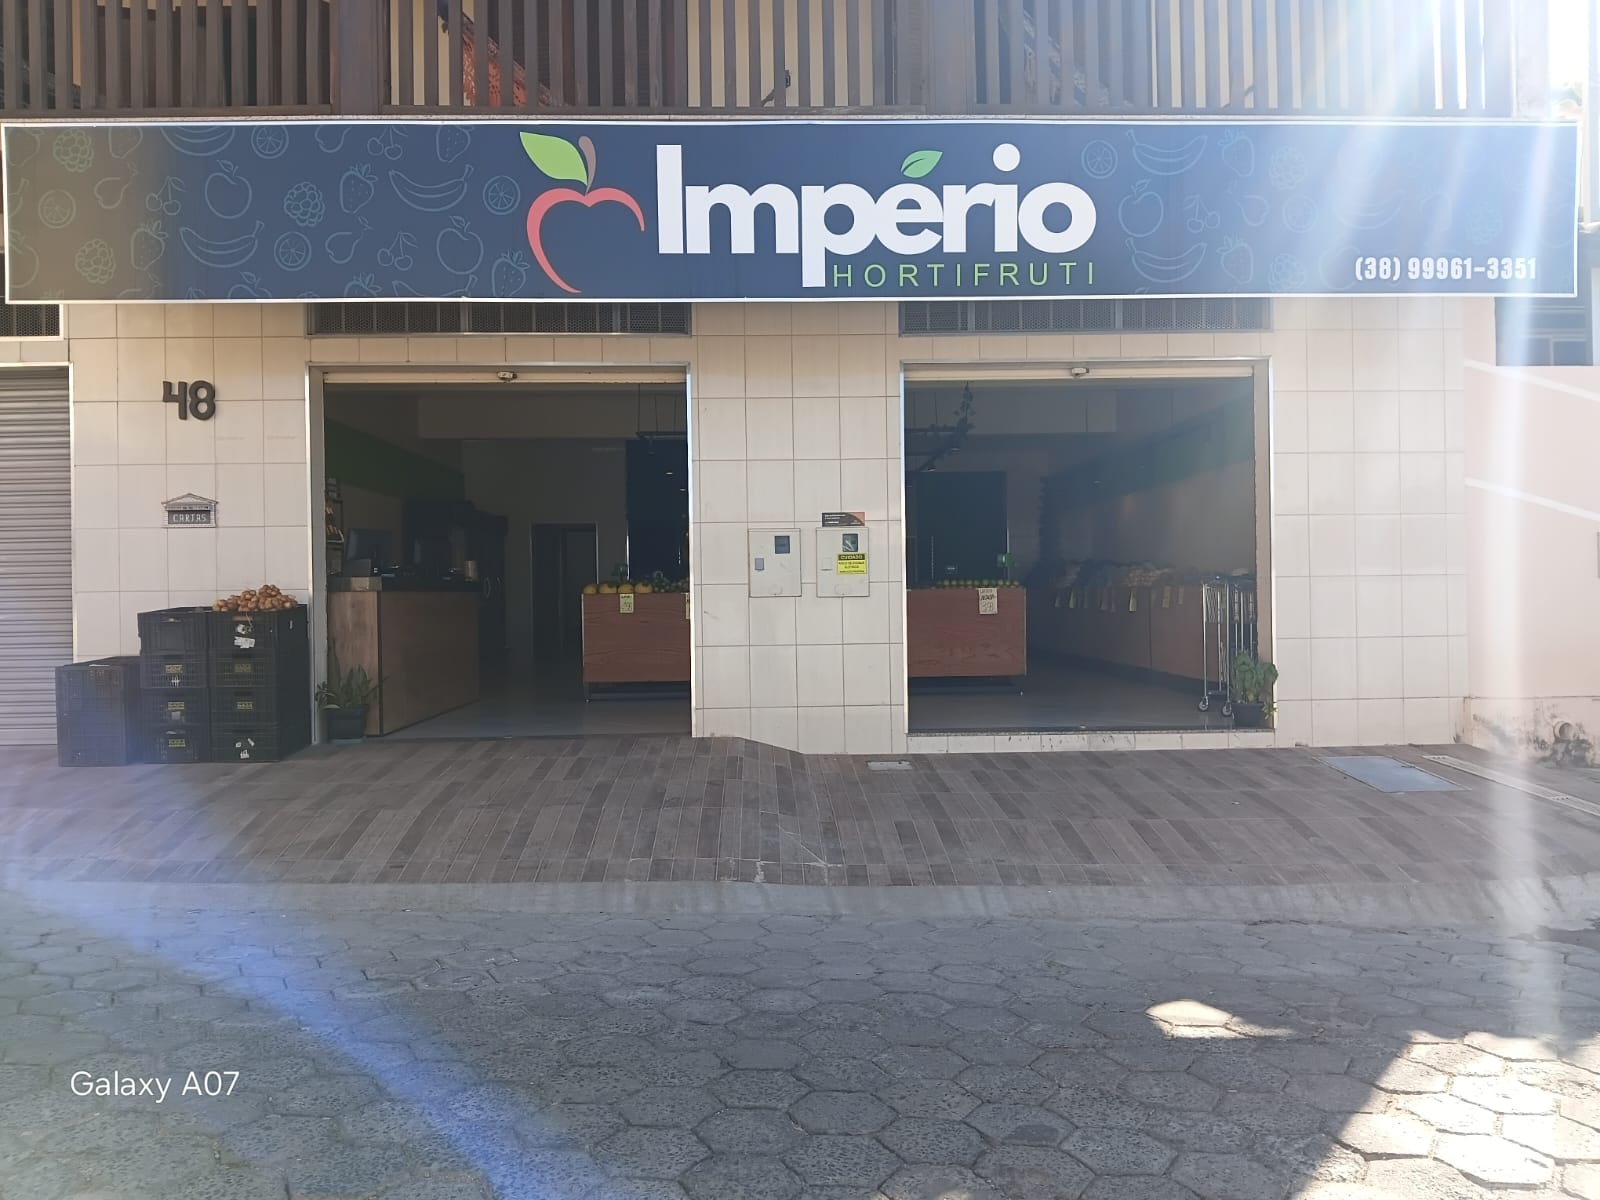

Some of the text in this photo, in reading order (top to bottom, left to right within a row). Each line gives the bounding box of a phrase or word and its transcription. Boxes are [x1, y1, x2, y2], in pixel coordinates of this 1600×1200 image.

[832, 261, 1095, 287] HORTIFRUTI
[1355, 256, 1537, 281] (38) 99961-3351
[163, 380, 216, 421] 48
[172, 513, 207, 522] CARTAS
